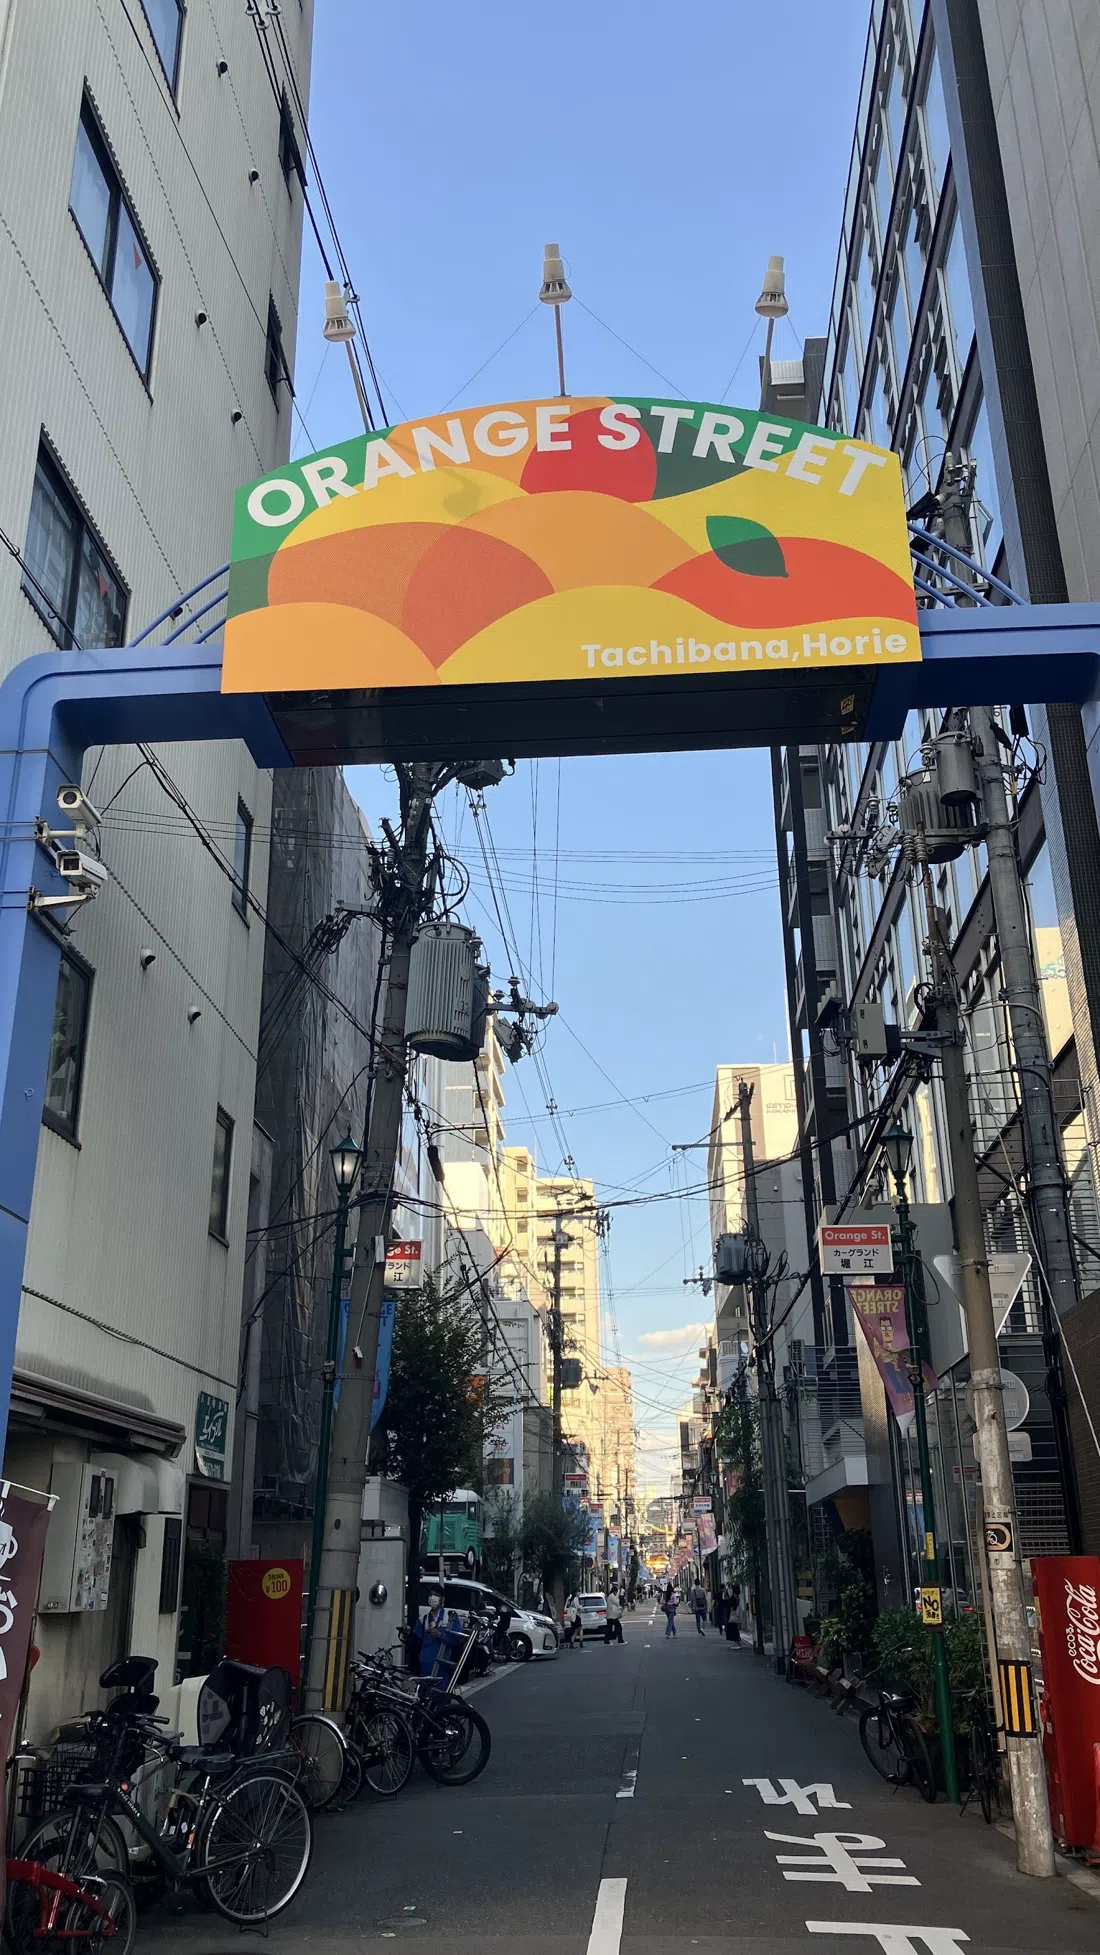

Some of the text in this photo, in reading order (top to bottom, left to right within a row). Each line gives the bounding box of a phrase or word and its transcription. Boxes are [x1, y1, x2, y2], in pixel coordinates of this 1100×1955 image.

[246, 403, 888, 528] ORANGE STREET
[580, 628, 908, 669] Tachibana,Horie
[825, 1230, 886, 1242] Orange St.
[404, 1244, 418, 1255] St.
[833, 1248, 879, 1257] カーグランド
[1064, 1579, 1100, 1685] Coca-Cola
